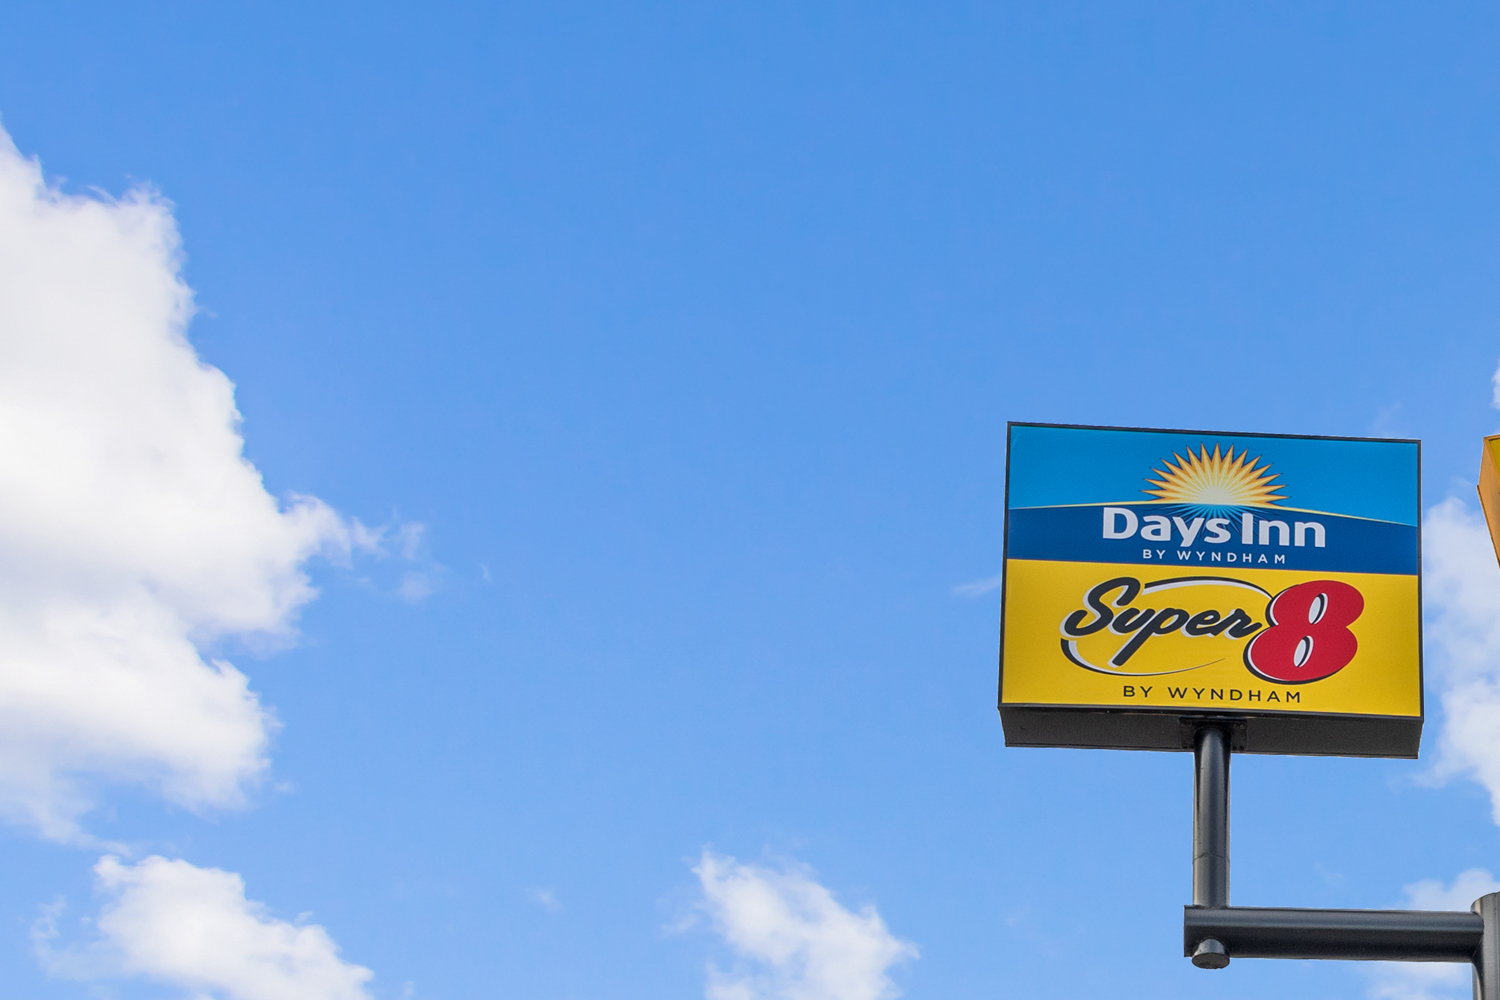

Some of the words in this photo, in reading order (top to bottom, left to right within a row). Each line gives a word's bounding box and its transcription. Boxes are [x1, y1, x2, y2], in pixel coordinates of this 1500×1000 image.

[1102, 507, 1232, 547] Days
[1242, 513, 1326, 548] Inn
[1143, 549, 1166, 560] BY
[1177, 551, 1286, 565] WYNDHAM
[1059, 577, 1263, 668] Super
[1243, 579, 1365, 685] 8
[1123, 685, 1153, 698] BY
[1167, 687, 1301, 703] WYNDHAM
